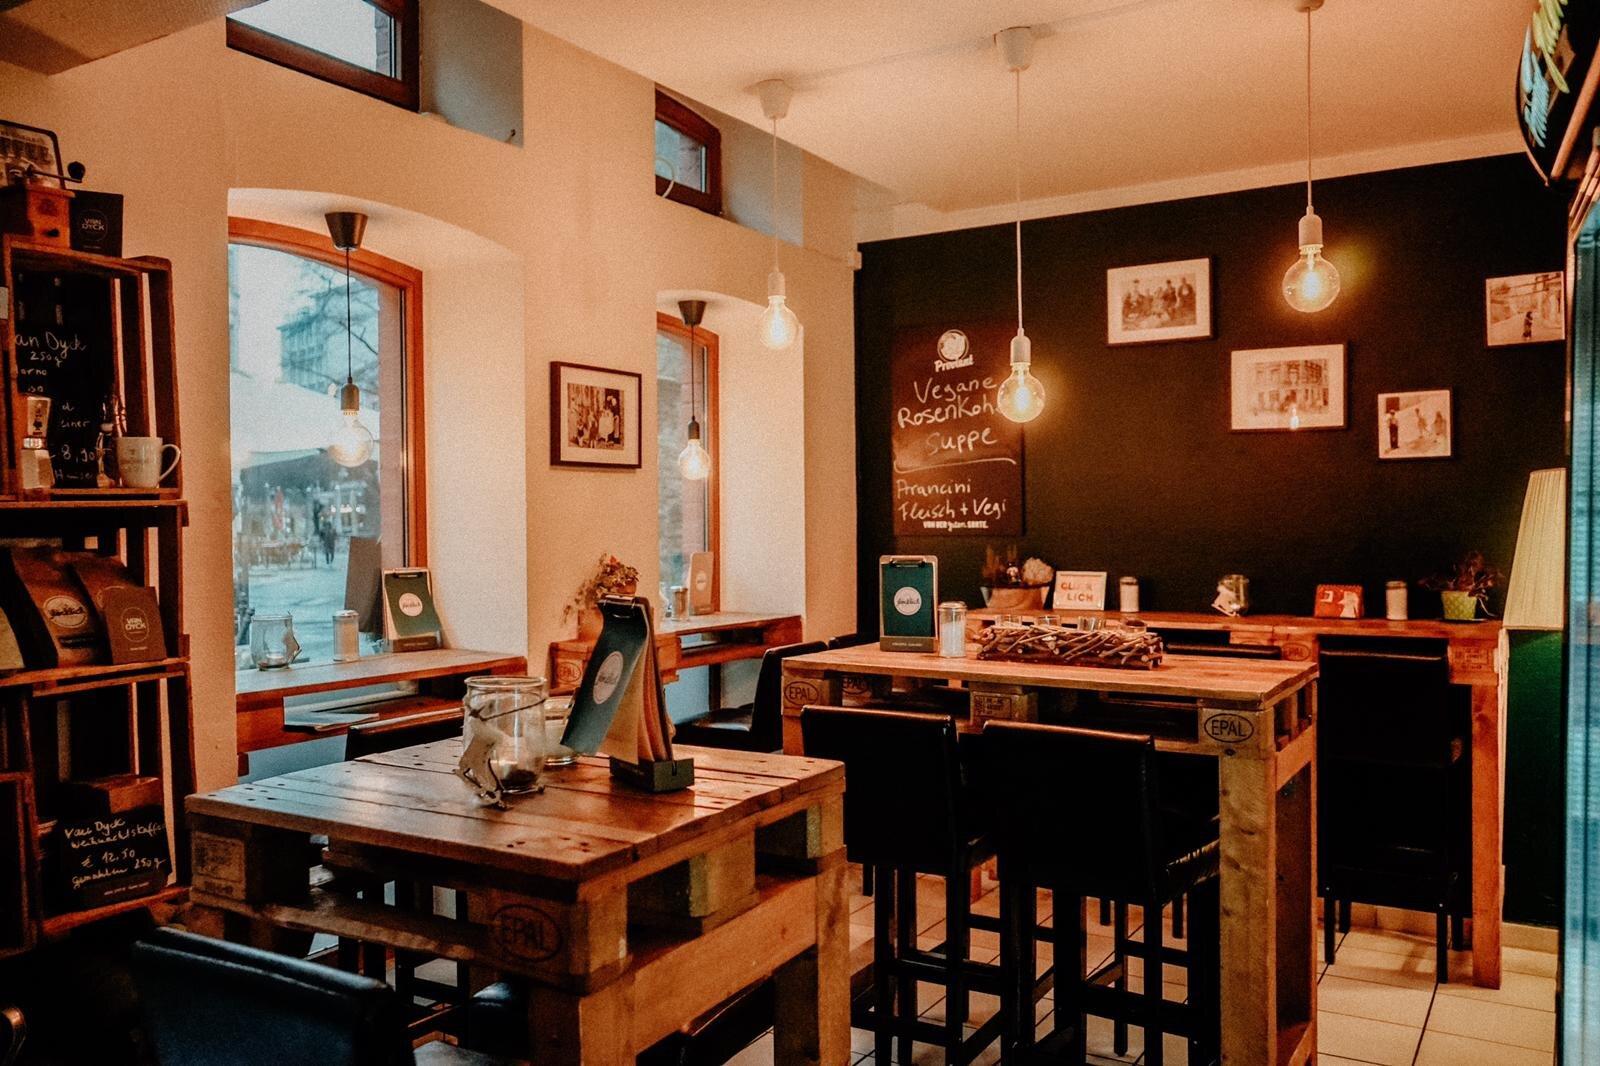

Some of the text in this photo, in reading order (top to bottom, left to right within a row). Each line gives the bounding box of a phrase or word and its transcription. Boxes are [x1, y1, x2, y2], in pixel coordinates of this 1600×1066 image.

[81, 223, 105, 231] DYCK
[15, 331, 87, 360] an Dyck
[913, 376, 998, 404] Vegane
[925, 427, 998, 456] Suppe
[896, 478, 972, 499] Arancini
[898, 499, 956, 521] Fleisch
[973, 497, 1006, 519] Vegi
[1067, 592, 1094, 602] LICH
[125, 623, 146, 631] DYCK
[559, 665, 577, 678] EPAL
[788, 685, 813, 700] EPAL
[1211, 719, 1247, 737] EPAL
[94, 818, 126, 836] Dyck
[501, 914, 553, 953] EPAL
